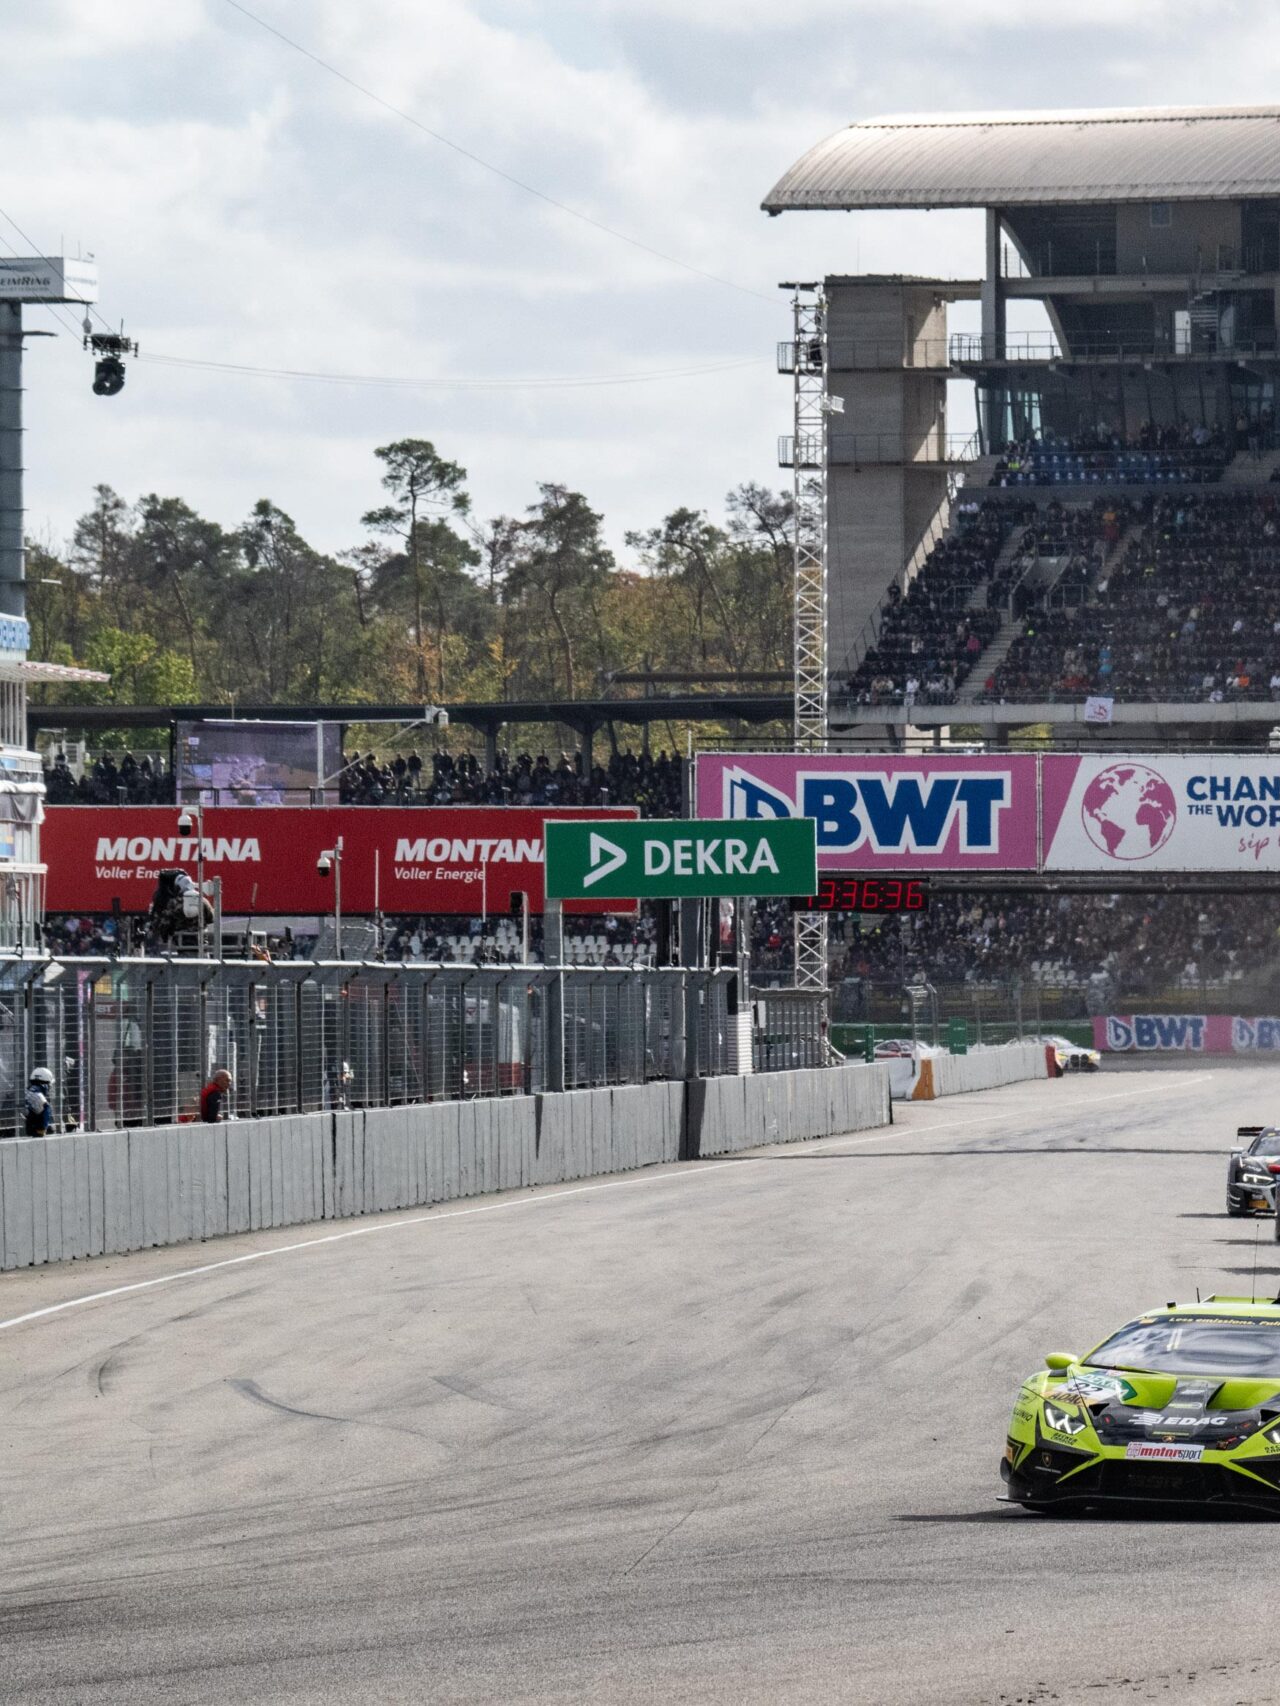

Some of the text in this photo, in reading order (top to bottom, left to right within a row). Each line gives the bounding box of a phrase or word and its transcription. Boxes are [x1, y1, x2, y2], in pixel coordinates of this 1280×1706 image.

[800, 776, 1008, 849] BWT
[1188, 805, 1212, 815] THE
[95, 837, 261, 861] MONTANA
[1238, 833, 1270, 860] sip
[643, 837, 780, 876] DEKRA
[96, 866, 132, 879] Voller
[394, 867, 485, 884] Voller Energie
[1133, 1015, 1208, 1049] BWT
[1195, 1318, 1256, 1326] emissions.
[1166, 1416, 1228, 1426] EDAG
[1140, 1446, 1202, 1460] motorsport
